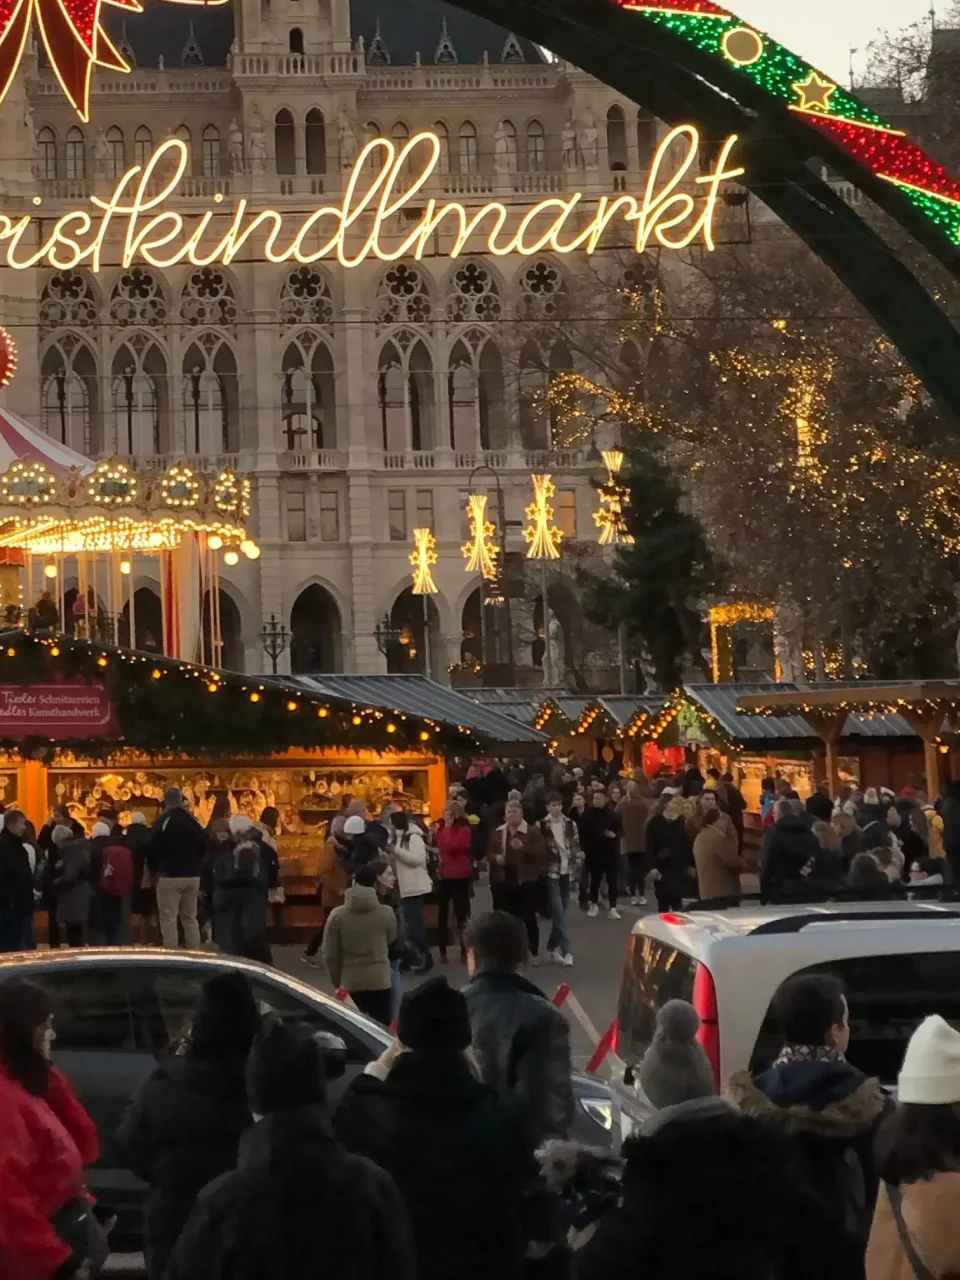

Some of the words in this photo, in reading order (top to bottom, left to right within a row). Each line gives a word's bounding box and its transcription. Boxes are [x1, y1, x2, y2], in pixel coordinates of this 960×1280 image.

[1, 691, 37, 704] Tiroler
[39, 694, 100, 705] Schnitzereien
[28, 706, 100, 718] Kunsthandwerk
